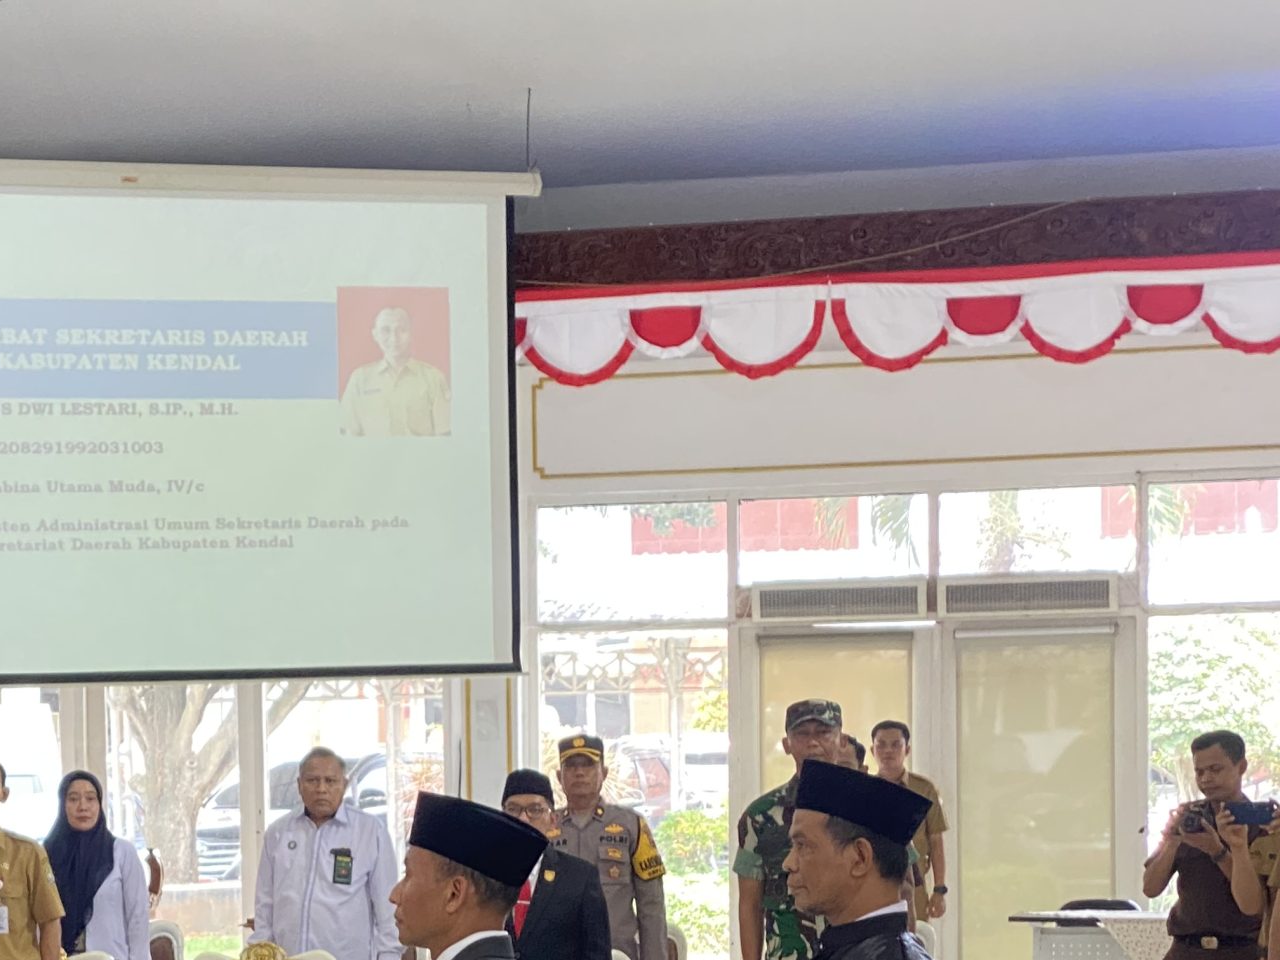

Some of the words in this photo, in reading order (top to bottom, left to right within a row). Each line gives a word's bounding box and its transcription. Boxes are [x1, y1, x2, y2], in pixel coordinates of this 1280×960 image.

[56, 327, 206, 346] SEKRETARIS
[213, 329, 309, 347] DAERAH
[147, 354, 242, 371] KENDAL
[17, 402, 54, 416] DWI
[60, 402, 143, 418] LESTARI,
[200, 402, 239, 416] M.H.
[47, 480, 103, 494] Utama
[109, 479, 161, 496] Muda,
[167, 479, 205, 494] IV/c
[36, 518, 148, 533] Administrasi
[154, 518, 210, 531] Umum
[215, 517, 302, 531] Sekretaris
[306, 516, 366, 530] Daerah
[371, 516, 410, 532] pada
[71, 537, 133, 551] Daerah
[138, 536, 230, 552] Kabupaten
[235, 535, 295, 550] Kendal
